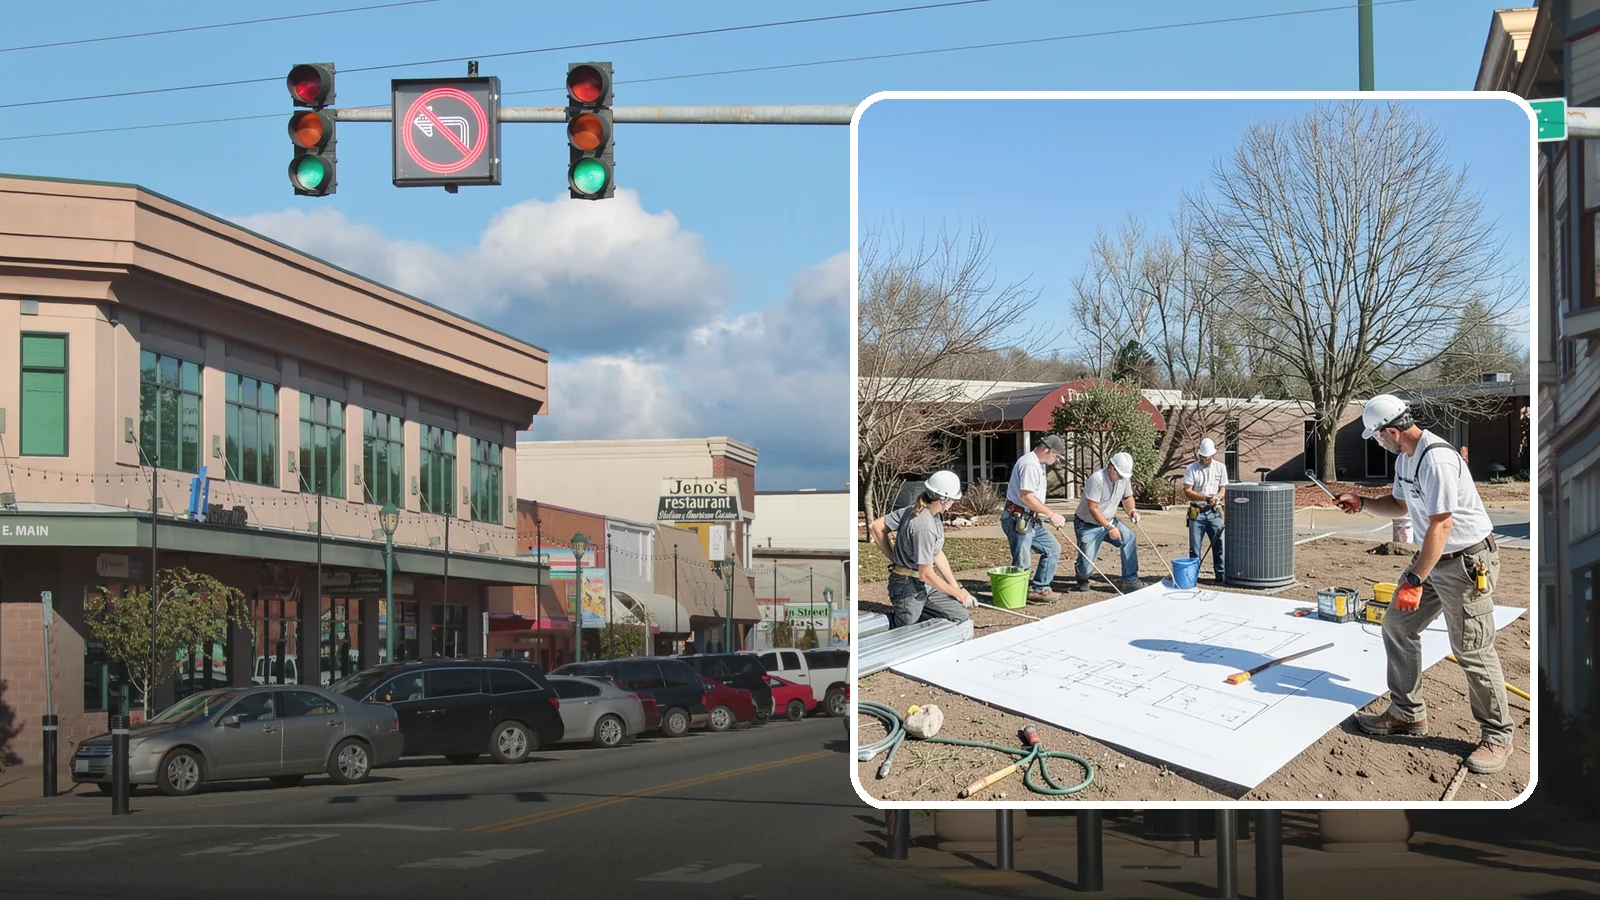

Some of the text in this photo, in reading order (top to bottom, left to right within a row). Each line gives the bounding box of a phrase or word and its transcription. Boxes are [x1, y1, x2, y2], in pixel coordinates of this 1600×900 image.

[670, 480, 727, 494] Jeno's
[665, 496, 731, 509] restaurant
[659, 510, 681, 519] Italian
[686, 509, 714, 519] American
[715, 509, 737, 519] Cuisine
[2, 525, 49, 536] E. MAIN
[797, 607, 828, 616] Street
[790, 619, 824, 627] lass
